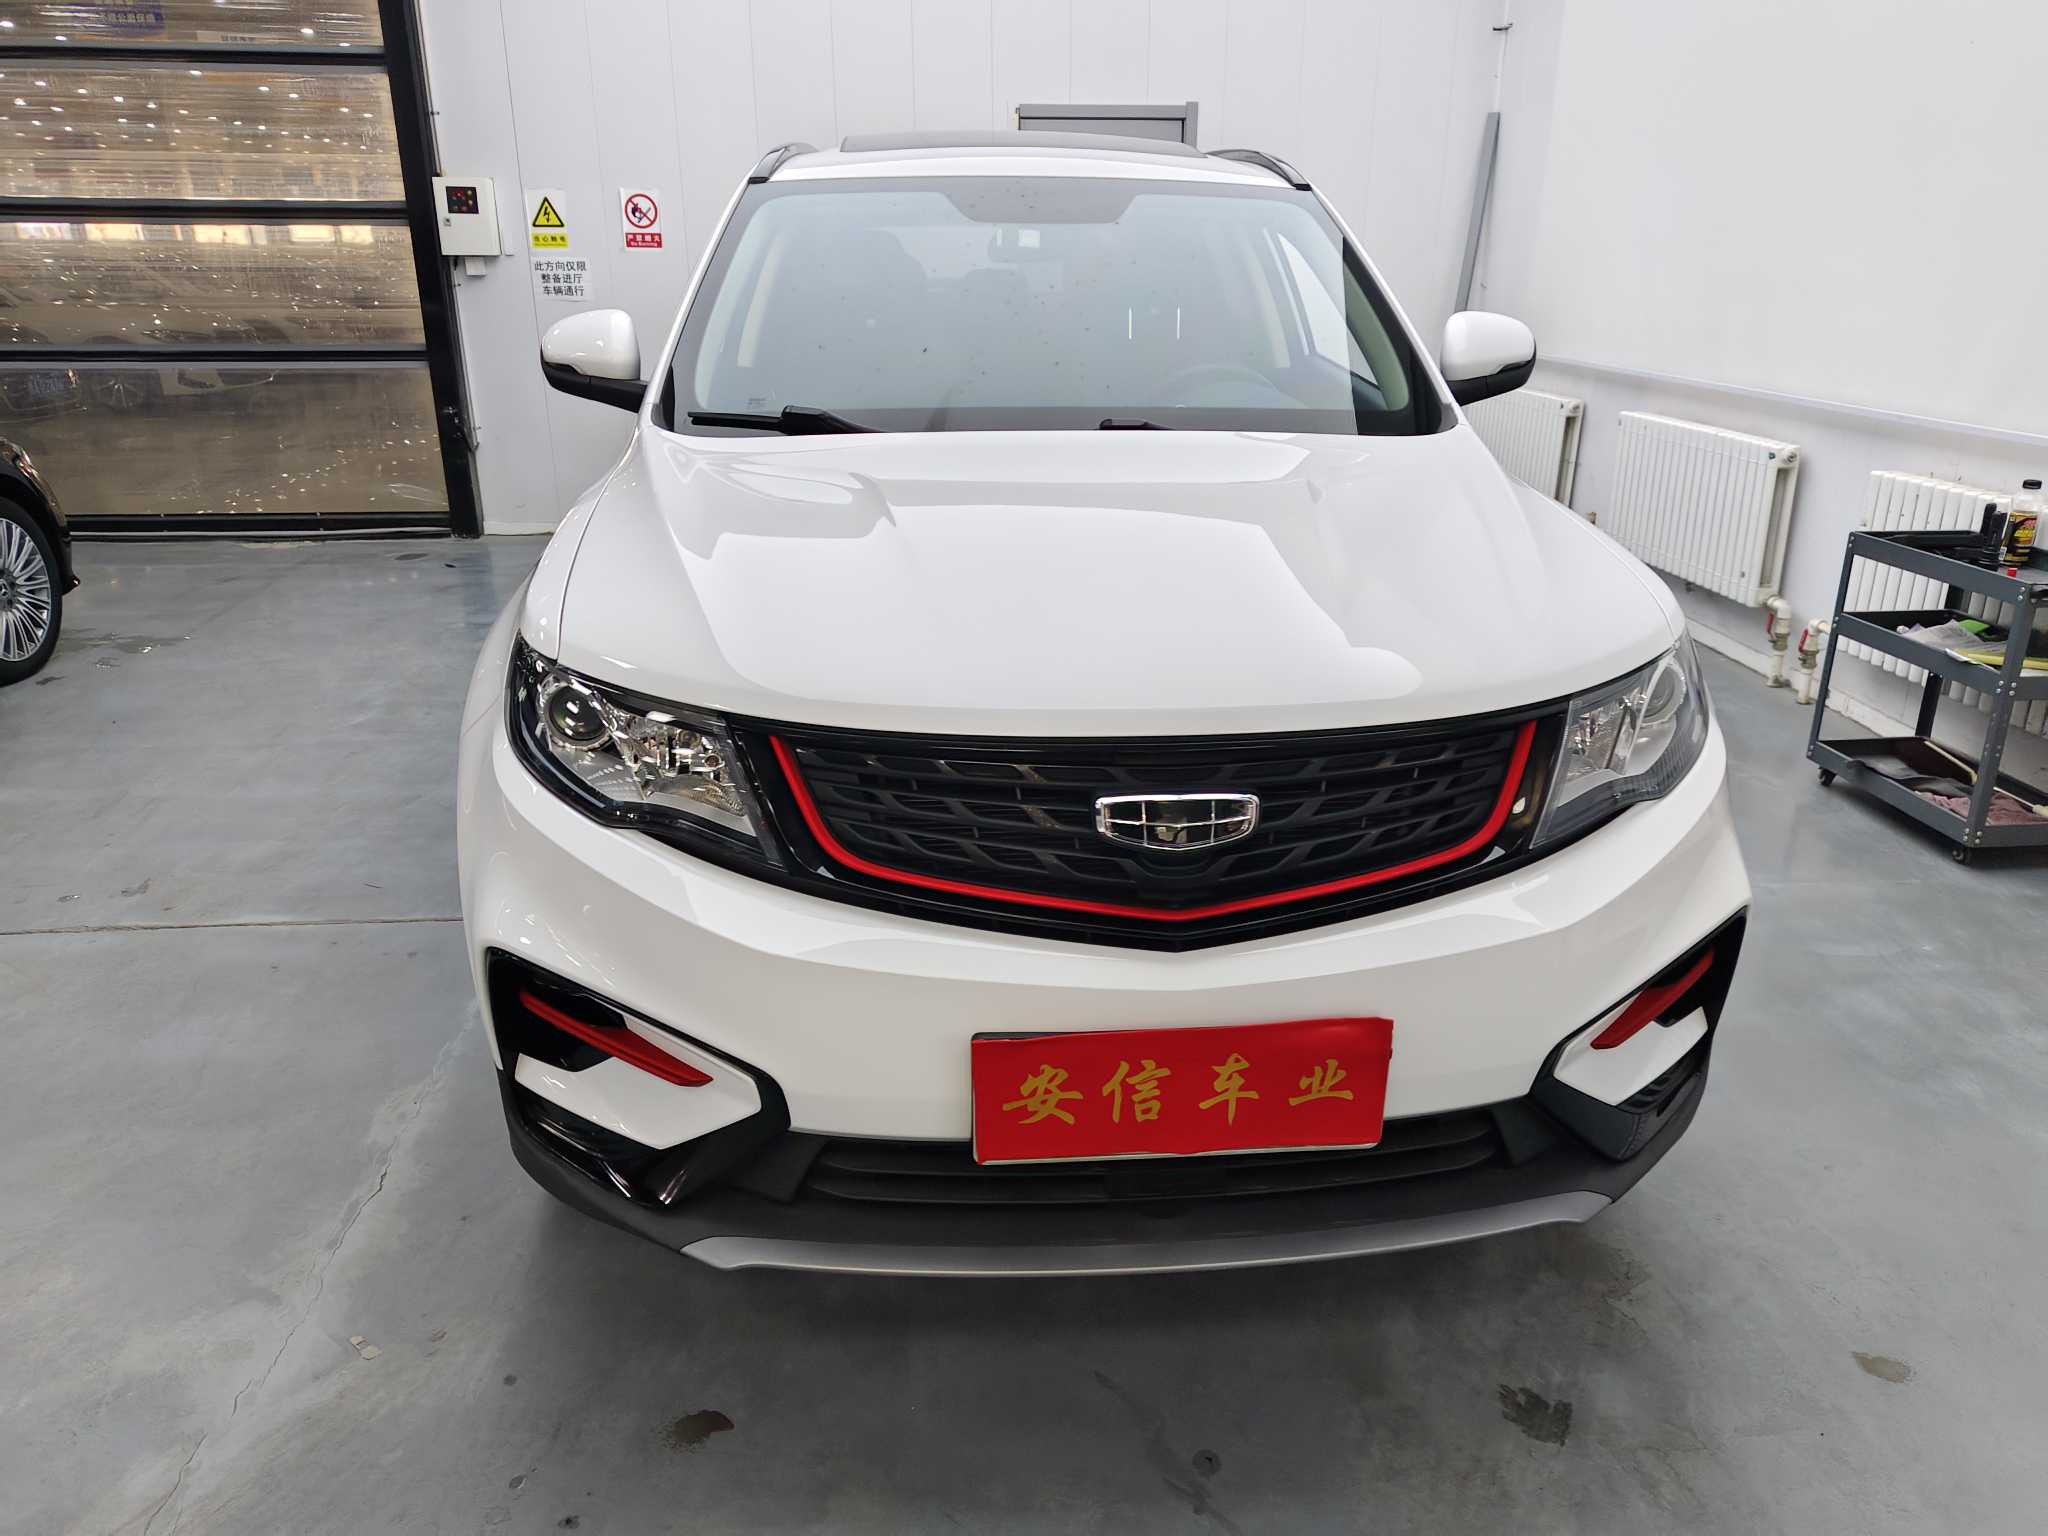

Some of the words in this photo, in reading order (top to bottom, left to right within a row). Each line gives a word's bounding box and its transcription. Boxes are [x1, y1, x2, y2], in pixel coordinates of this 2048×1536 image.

[534, 261, 587, 271] 此方向仅限
[542, 285, 585, 296] 车辆通行
[1002, 1053, 1353, 1124] 安信车业
